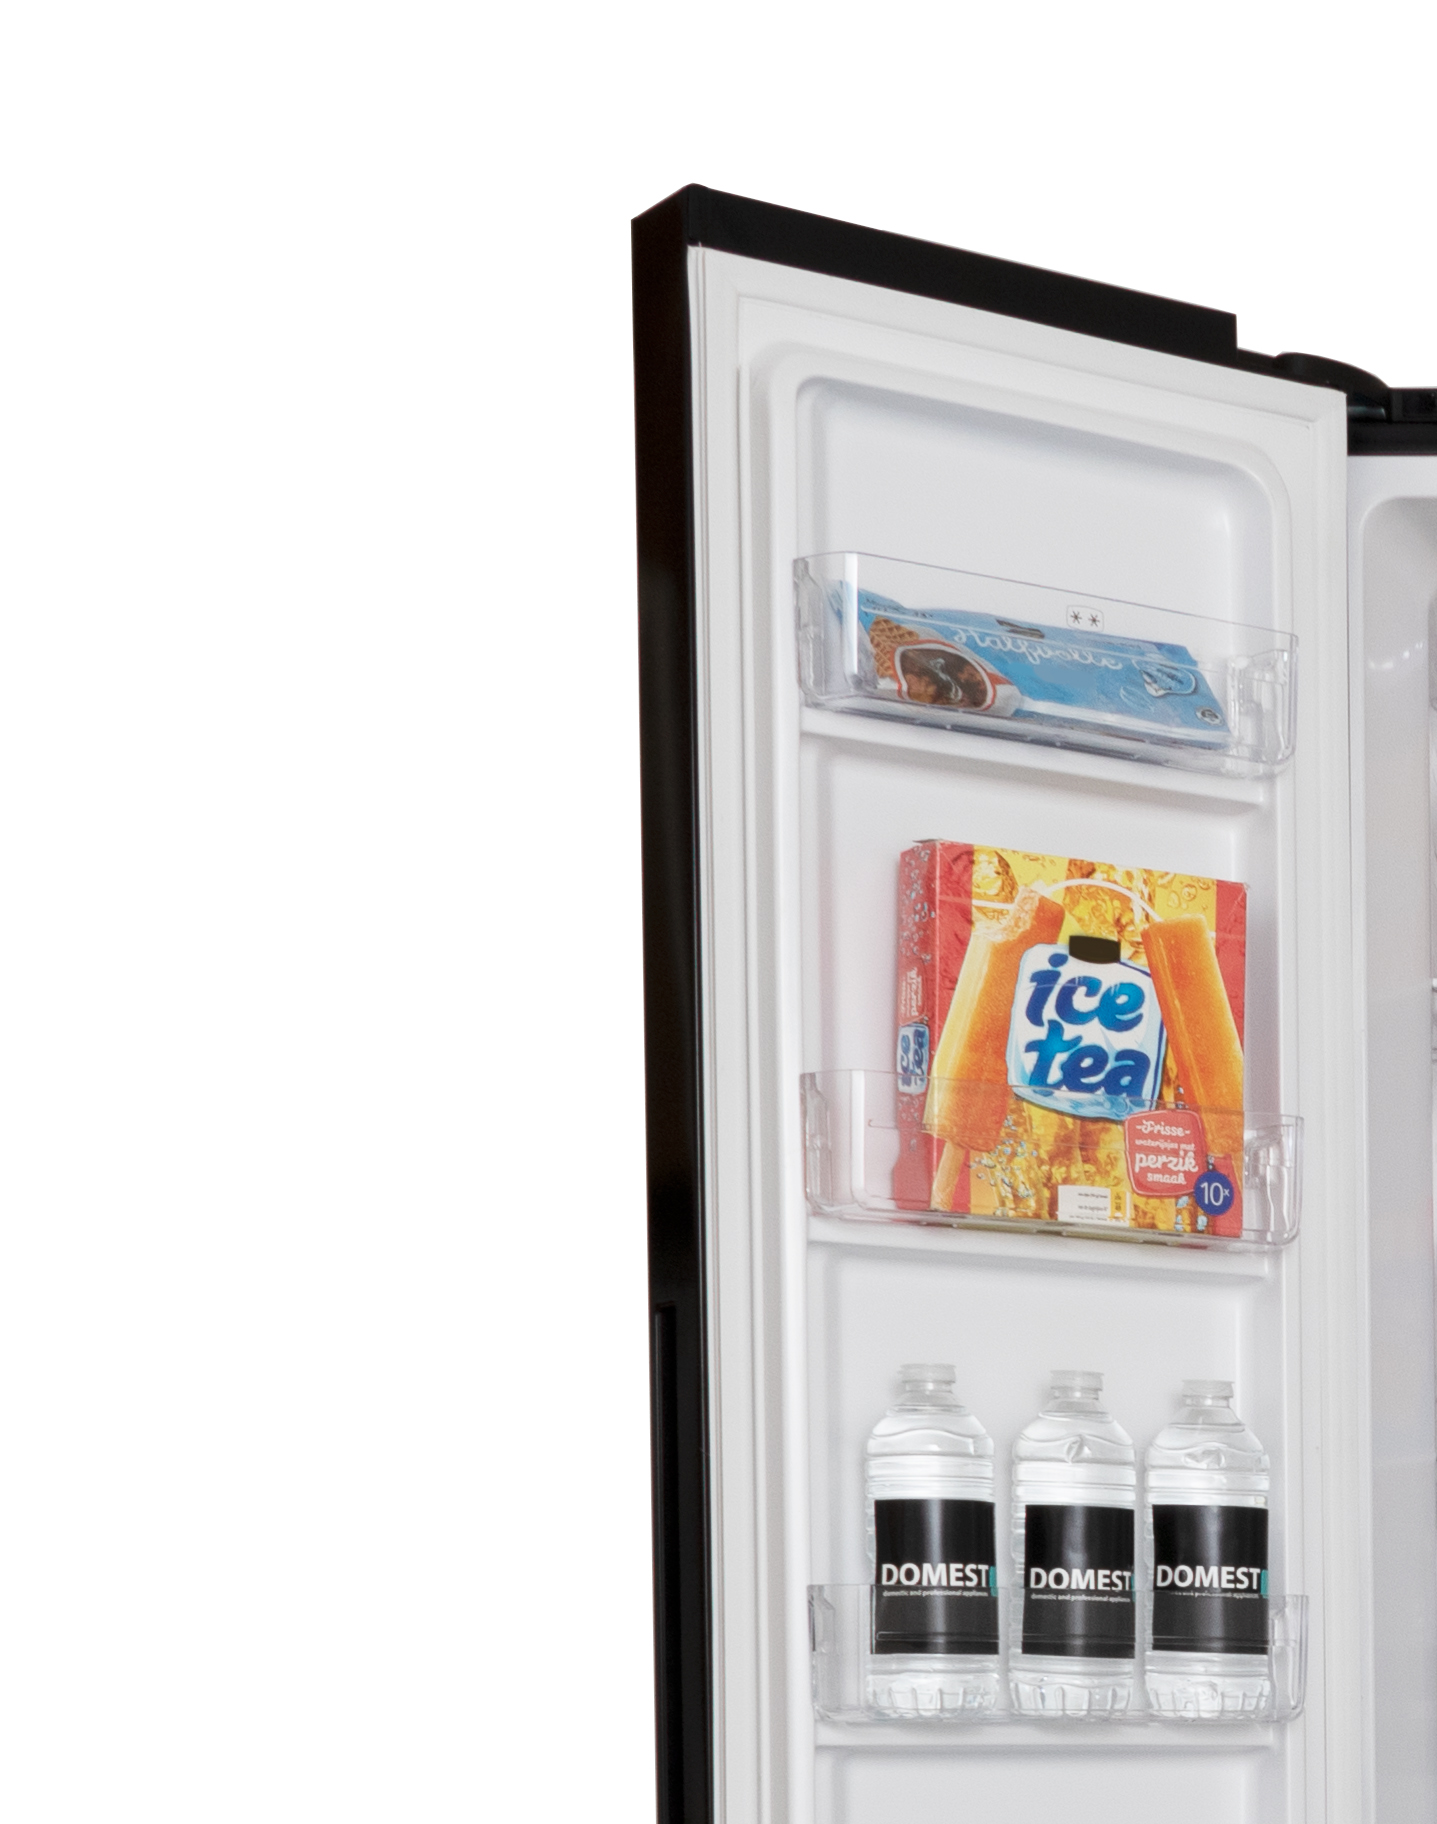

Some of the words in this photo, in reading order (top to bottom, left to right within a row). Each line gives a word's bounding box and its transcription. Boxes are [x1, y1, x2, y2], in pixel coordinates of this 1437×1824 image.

[1025, 953, 1146, 1032] ice
[1024, 1020, 1152, 1098] tea
[1135, 1150, 1199, 1173] perzik
[1147, 1172, 1187, 1185] smaak
[881, 1562, 989, 1587] DOMEST
[1030, 1567, 1132, 1591] DOMEST
[1156, 1564, 1261, 1590] DOMEST
